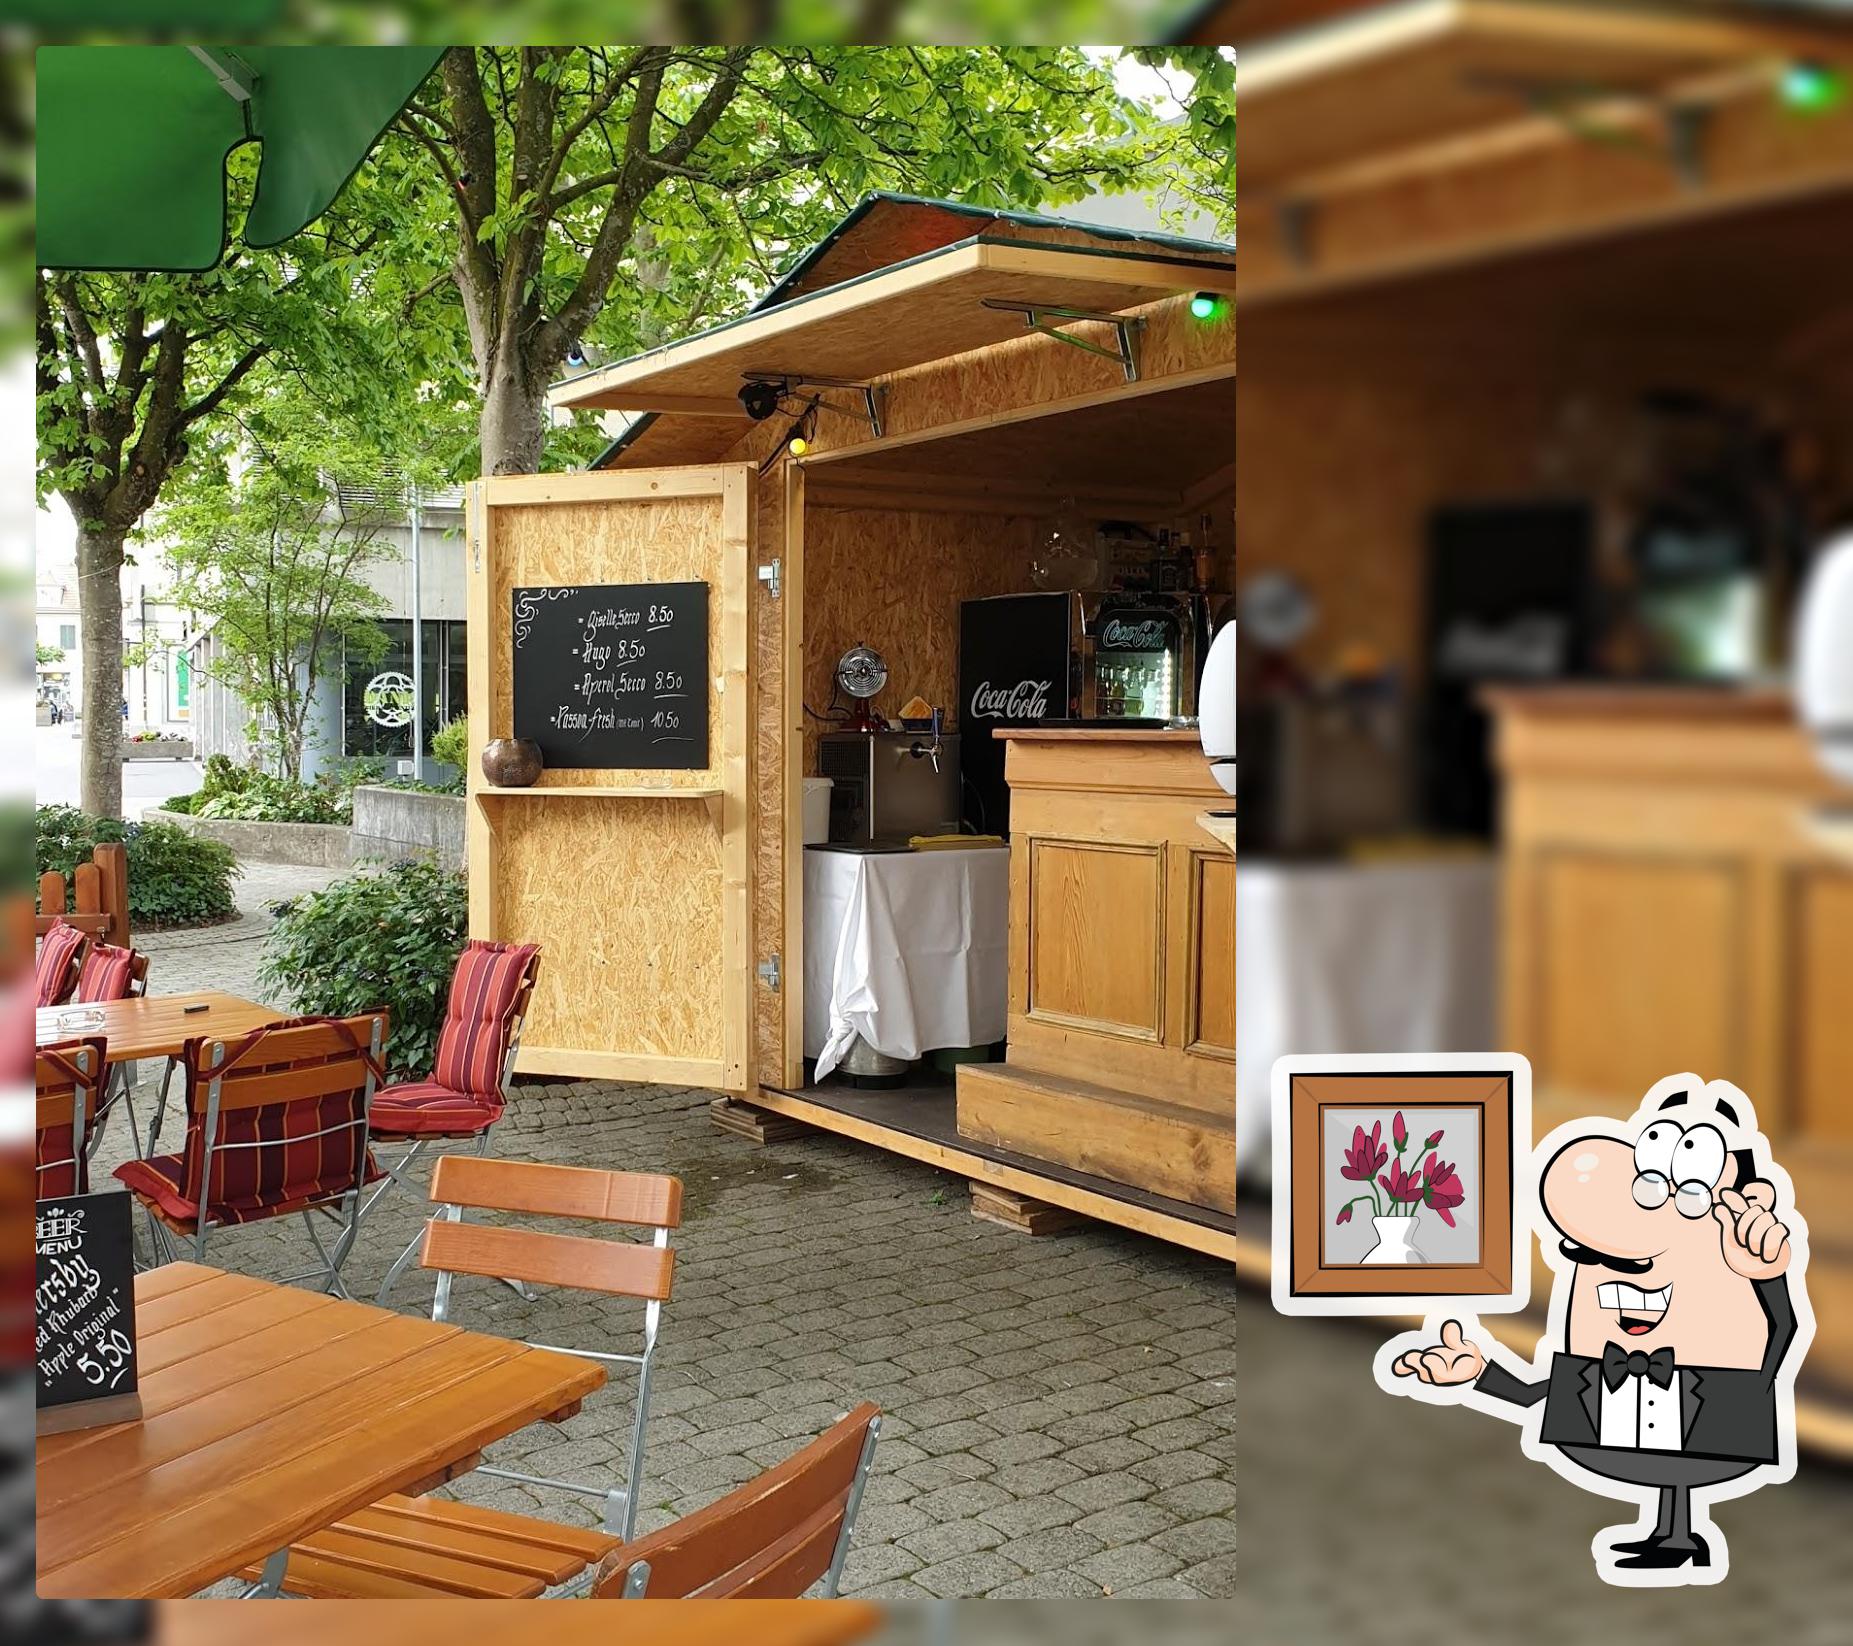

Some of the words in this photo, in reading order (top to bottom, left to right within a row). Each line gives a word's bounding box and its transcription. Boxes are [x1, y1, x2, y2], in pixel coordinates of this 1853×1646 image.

[648, 605, 673, 623] 8.50
[582, 641, 611, 670] Hugo
[617, 639, 645, 659] 8.50
[582, 672, 615, 705] Aperol
[614, 672, 646, 700] Secco
[655, 671, 682, 690] 8.50
[971, 680, 1052, 718] Coca-Cola
[36, 1253, 101, 1317] ersby
[36, 1326, 51, 1352] ed
[76, 1328, 132, 1385] 5.50
